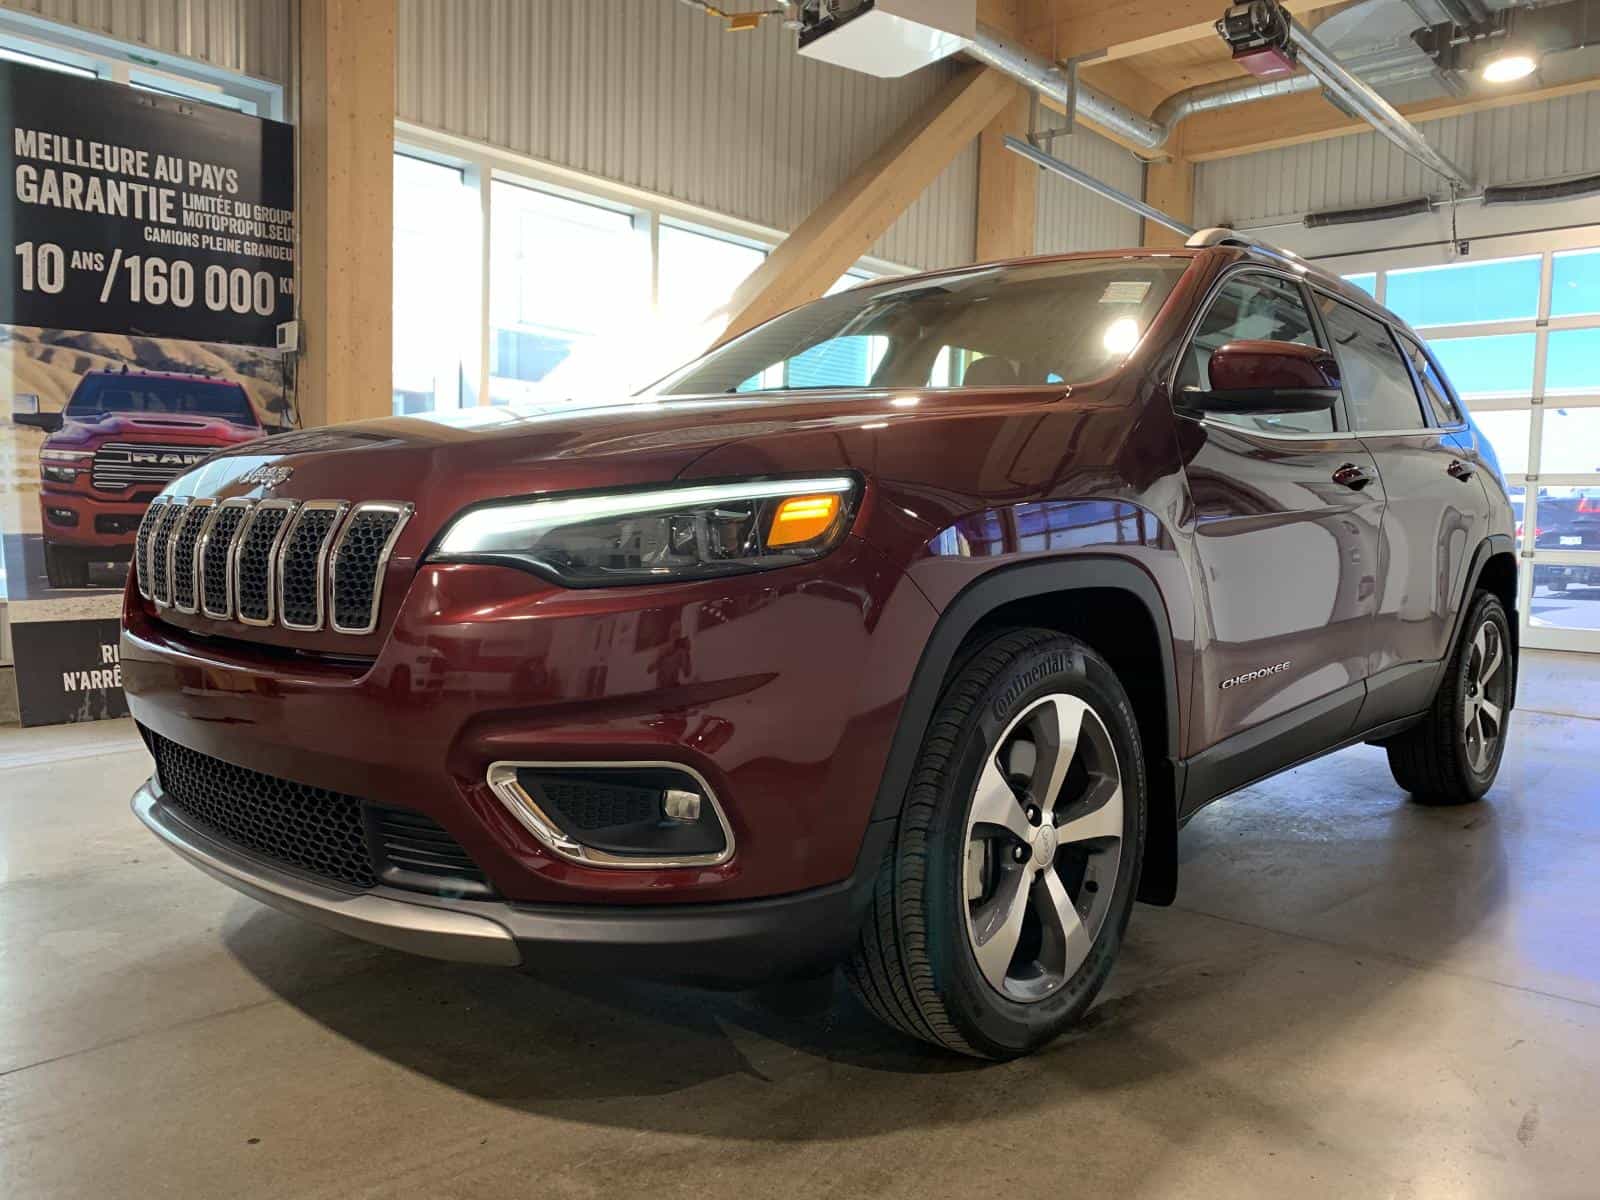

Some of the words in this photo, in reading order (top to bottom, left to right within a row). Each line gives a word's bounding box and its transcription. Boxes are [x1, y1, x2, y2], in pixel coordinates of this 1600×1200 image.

[15, 127, 150, 178] MEILLEURE
[154, 154, 183, 185] AU
[188, 160, 239, 194] PAYS
[15, 164, 177, 225] GARANTIE
[182, 192, 233, 216] LIMITÉE
[234, 201, 251, 219] DU
[253, 205, 293, 226] GROUP
[182, 210, 293, 242] MOTOPROPULSEU
[144, 227, 200, 249] CAMIONS
[201, 234, 242, 254] PLEINE
[243, 241, 293, 261] GRANDEU
[15, 241, 65, 294] 10
[205, 264, 275, 316] 000
[101, 644, 121, 663] RI
[63, 664, 122, 691] N'ARRÊ
[1218, 661, 1291, 689] CHEROKEE
